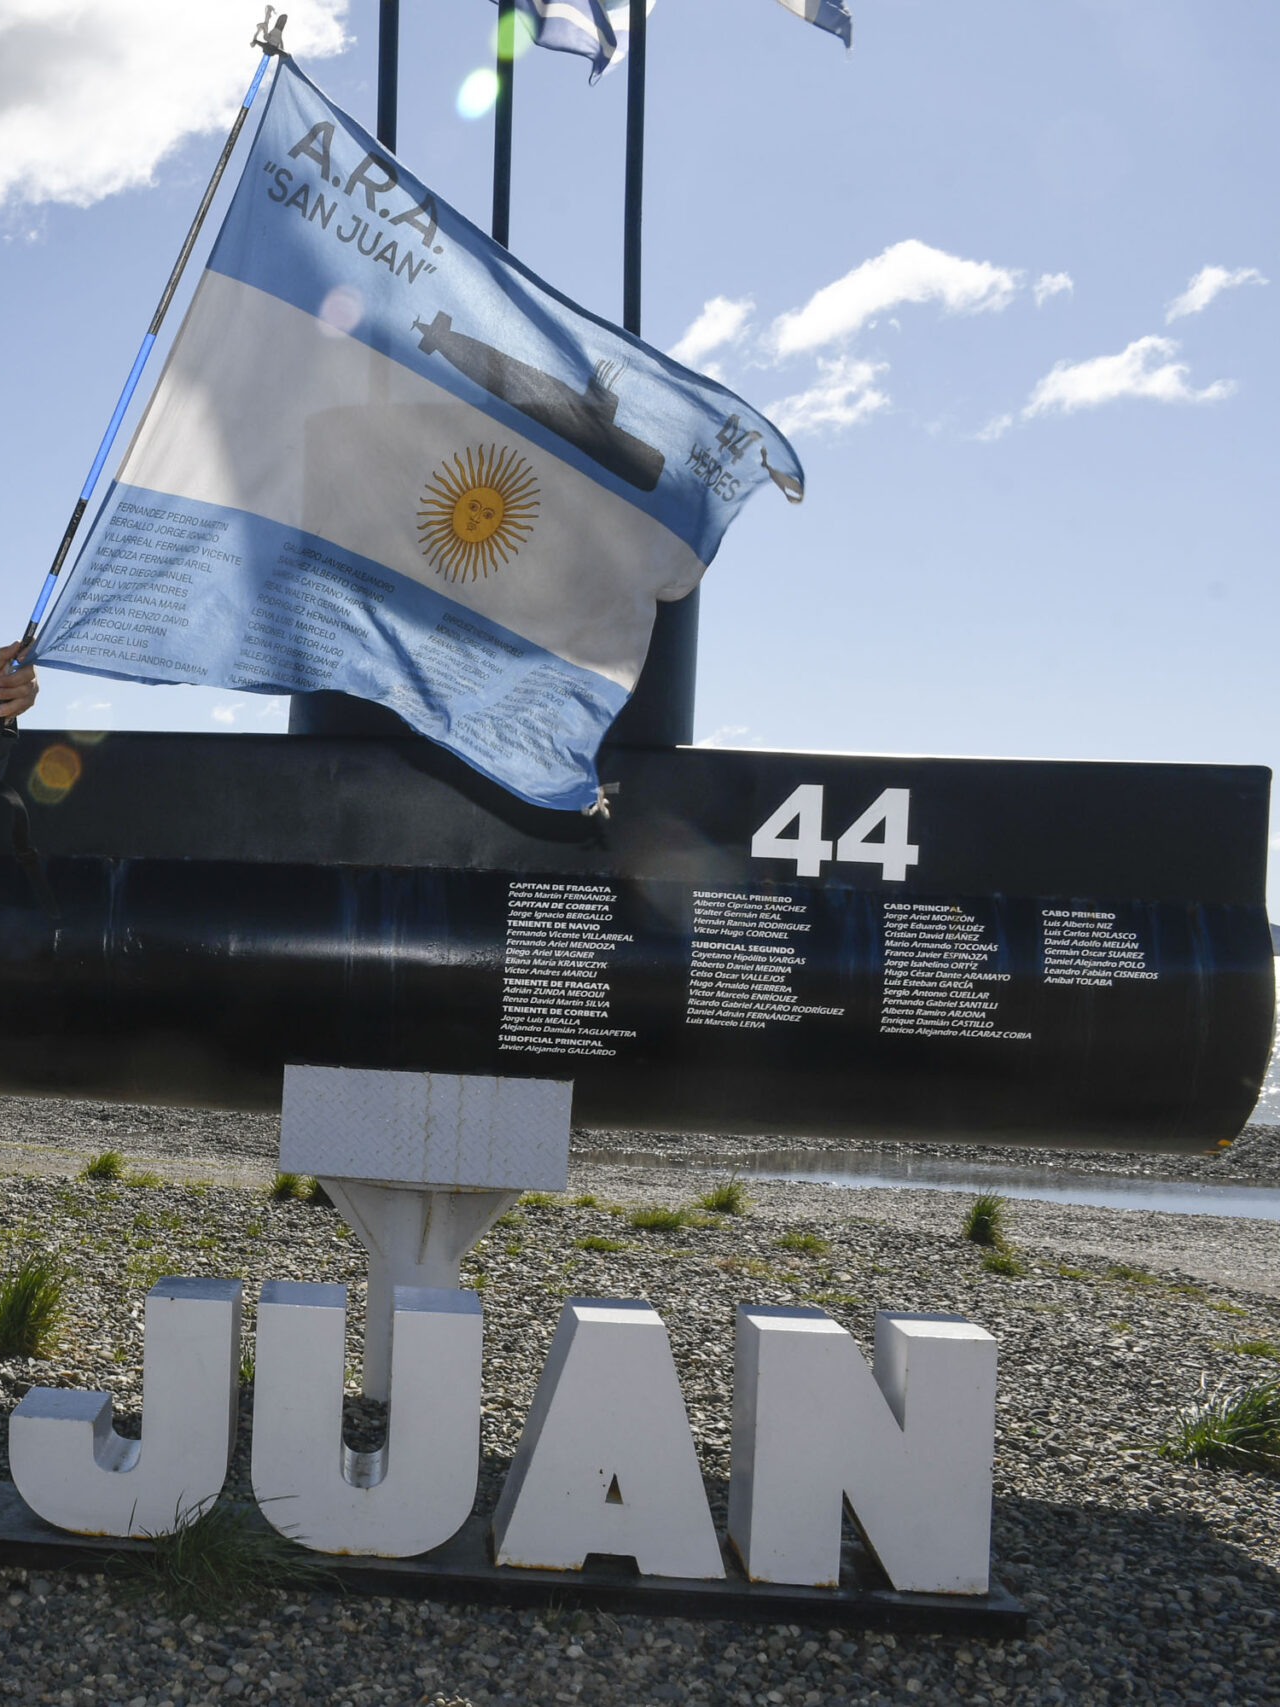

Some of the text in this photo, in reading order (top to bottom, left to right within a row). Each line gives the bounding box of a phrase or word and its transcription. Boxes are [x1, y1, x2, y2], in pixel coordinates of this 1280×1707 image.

[287, 120, 444, 254] A.R.A.
[263, 161, 438, 284] "SAN JUAN"
[117, 502, 198, 526] FERNANDEZ PEDRO
[110, 516, 187, 539] BERGALLO JORGE
[104, 531, 242, 565] VILLARREAL VICENTE
[90, 562, 127, 575] WAGNER
[185, 559, 212, 573] ARIEL
[150, 583, 189, 598] ANDRES
[318, 598, 351, 617] GERMAN
[162, 614, 189, 627] DAVID
[92, 618, 168, 637] MEOQUI ADRIAN
[295, 620, 336, 641] MARCELO
[91, 633, 149, 648] JORGE LUIS
[320, 643, 344, 658] HUGO
[118, 651, 208, 676] ALEJANDRO DAMIAN
[751, 784, 919, 881] 44
[693, 891, 792, 903] SUBOFICIAL PRIMERO
[566, 903, 609, 911] CORBETA
[693, 900, 725, 908] Alberto
[727, 902, 762, 910] Cipriano
[508, 910, 532, 918] Jorge
[884, 913, 908, 921] Jorge
[507, 920, 552, 928] TENIENTE
[884, 922, 908, 930] Jorge
[507, 929, 546, 937] Fernando
[720, 929, 789, 939] Hugo CORONEL
[1092, 932, 1136, 940] NOLASCO
[506, 948, 530, 956] Diego
[691, 942, 795, 954] SUBOFICIAL SEGUNDO
[692, 951, 731, 959] Cayetano
[769, 956, 806, 964] VARGAS
[691, 960, 725, 968] Roberto
[755, 965, 792, 973] MEDINA
[741, 974, 785, 982] VALLEJOS
[885, 969, 908, 977] Hugo
[963, 973, 1010, 981] ARAMAYO
[1114, 971, 1158, 979] CISNEROS
[503, 978, 548, 986] TENIENTE
[565, 982, 610, 990] FRAGATA
[751, 984, 792, 992] HERRERA
[1076, 978, 1112, 986] TOLABA
[716, 991, 749, 999] Marcelo
[950, 991, 989, 999] CUELLAR
[502, 1006, 547, 1014] TENIENTE
[564, 1009, 608, 1017] CORBETA
[951, 1020, 994, 1028] CASTILLO
[498, 1035, 603, 1046] SUBOFICIAL PRINCIPAL
[9, 1276, 998, 1595] JUAN
